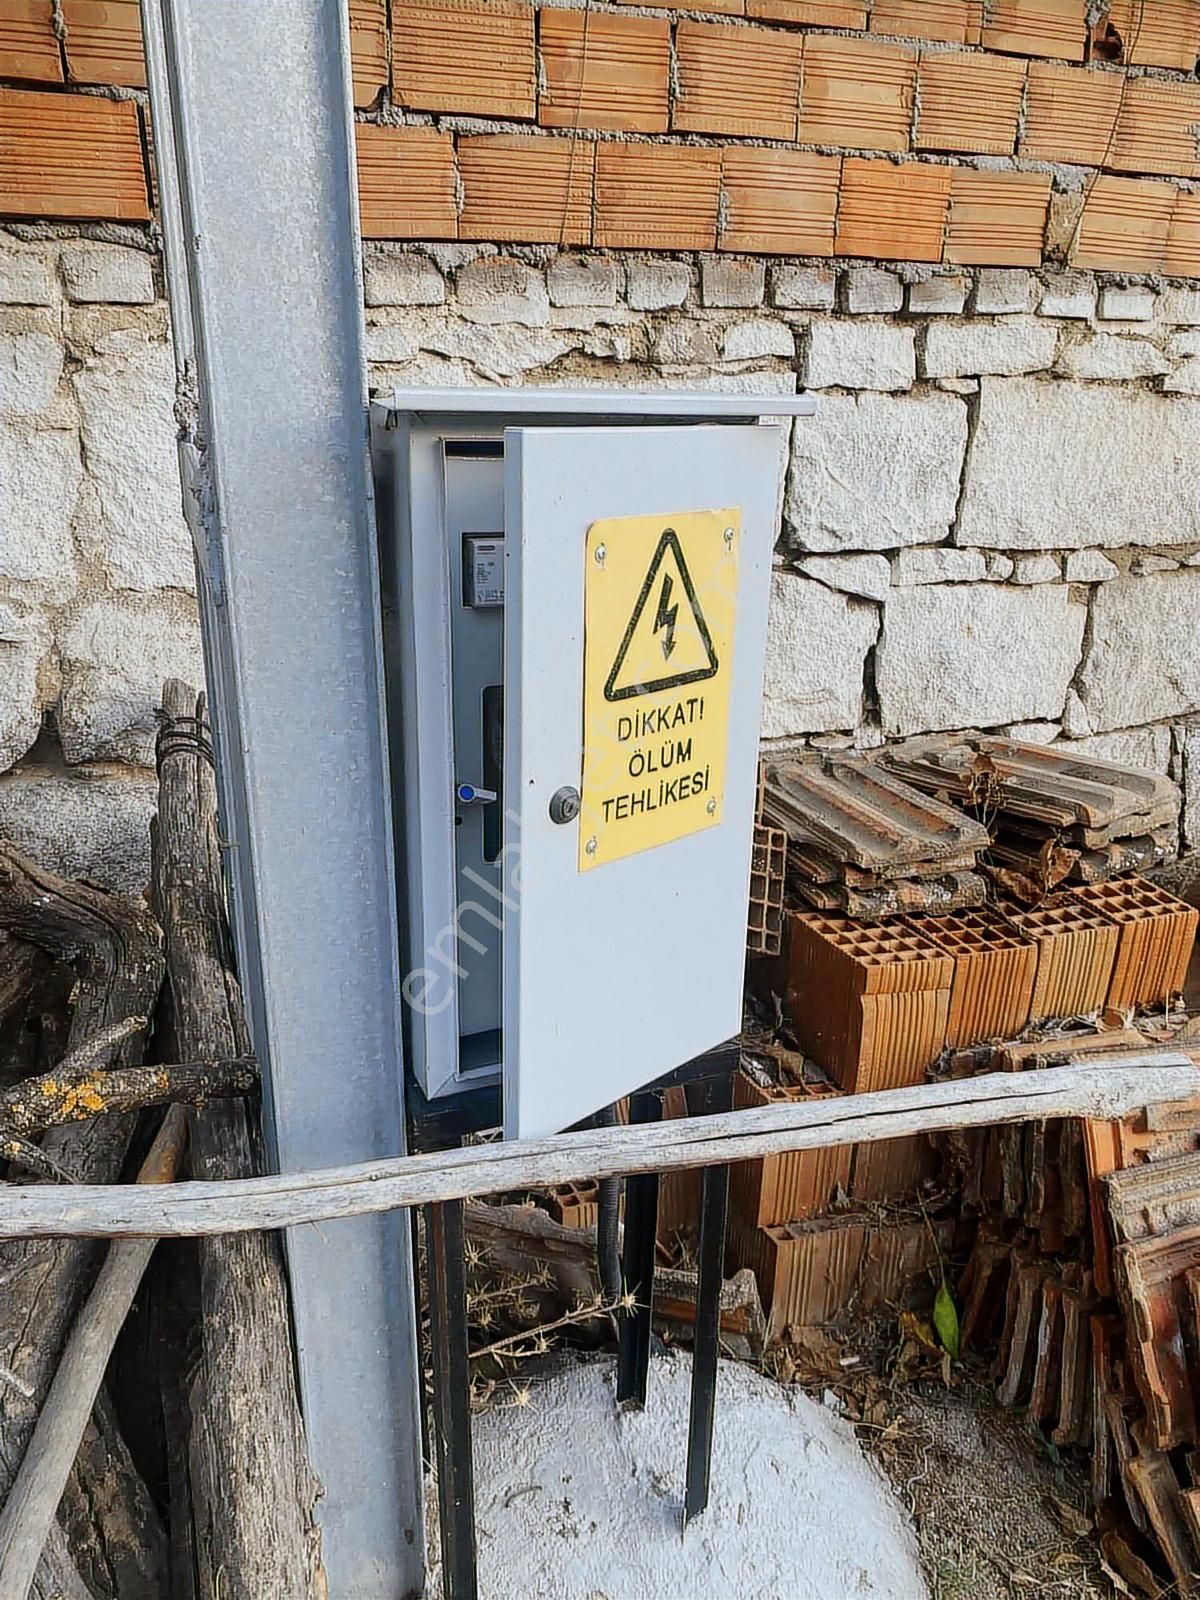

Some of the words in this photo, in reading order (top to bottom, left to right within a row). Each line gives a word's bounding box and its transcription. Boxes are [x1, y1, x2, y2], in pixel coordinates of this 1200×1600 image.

[617, 698, 705, 742] DİKKAT!
[628, 737, 692, 777] ÖLÜM
[602, 765, 710, 823] TEHLİKESİ
